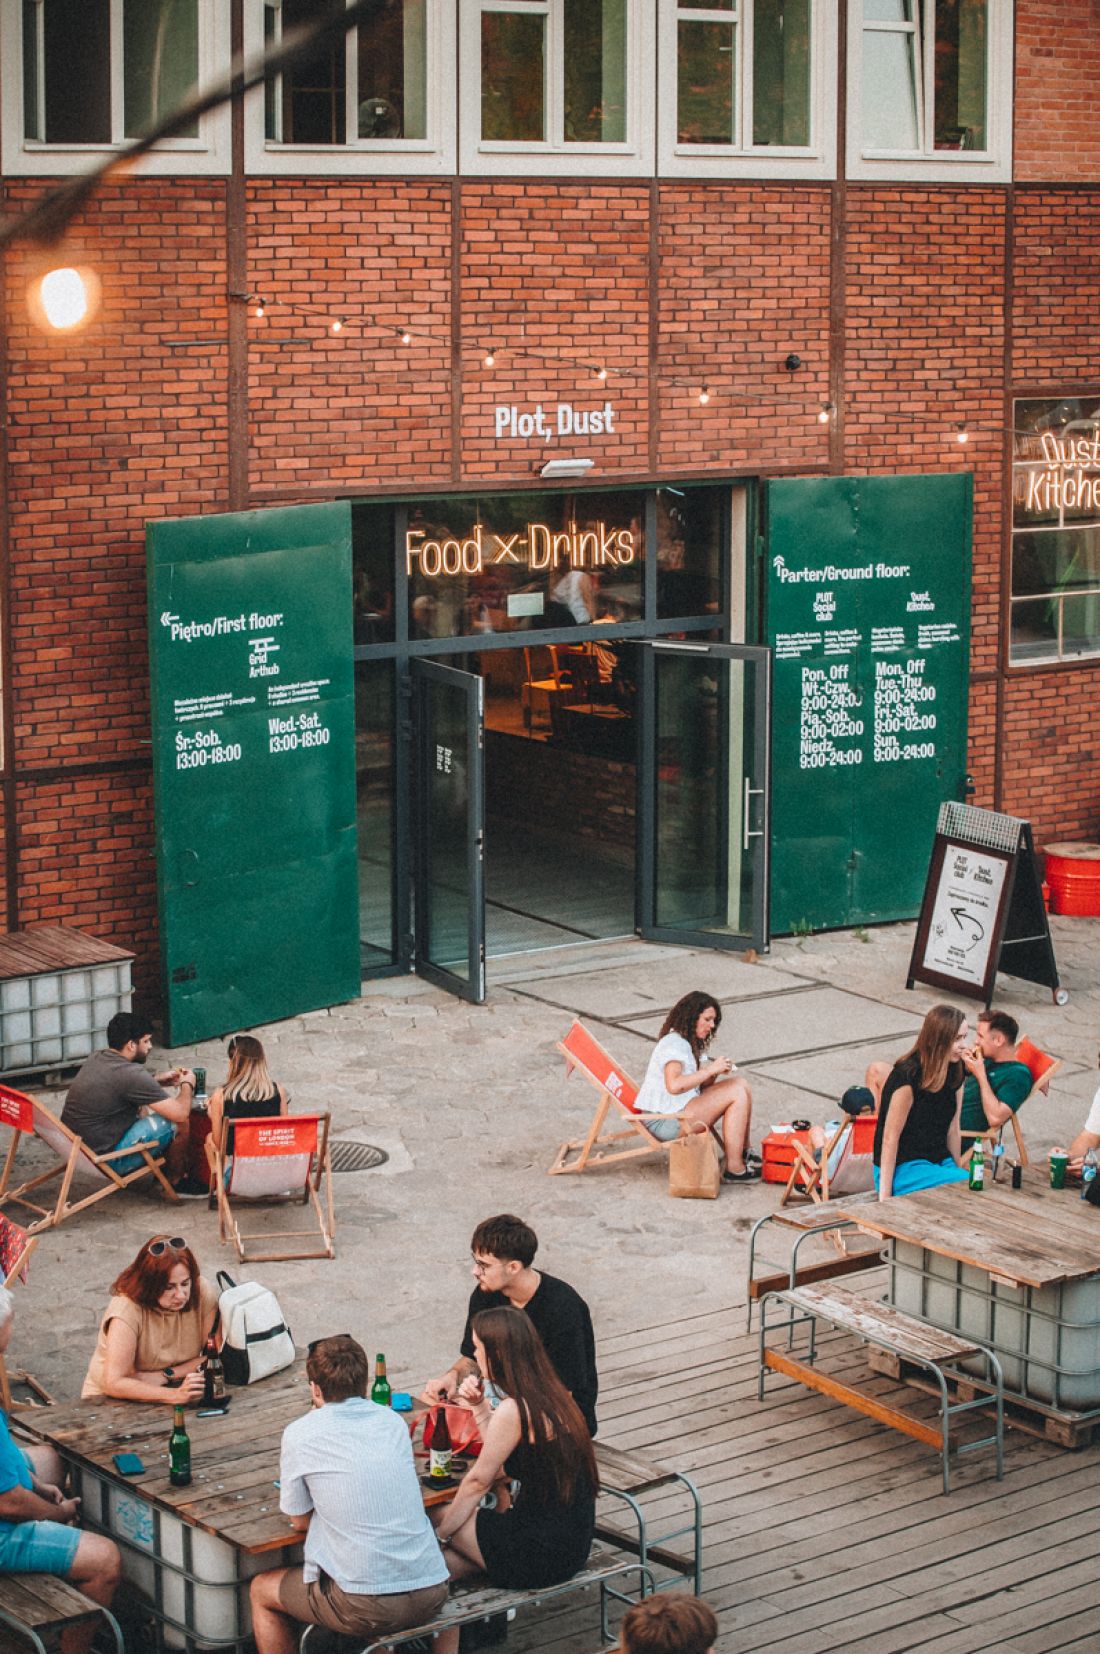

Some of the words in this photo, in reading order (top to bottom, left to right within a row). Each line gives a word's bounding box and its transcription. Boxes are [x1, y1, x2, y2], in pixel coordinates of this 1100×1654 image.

[496, 406, 551, 442] Plot,
[558, 403, 614, 435] Dust
[406, 525, 482, 576] Food
[530, 522, 634, 568] Drinks
[781, 564, 872, 583] Parter/Ground
[876, 564, 910, 578] floor:
[172, 614, 245, 642] Piętro/First
[250, 613, 283, 628] floor:
[249, 652, 267, 665] Grid
[876, 662, 904, 676] Mon.
[907, 659, 925, 673] Off
[249, 663, 279, 678] Arthub
[802, 667, 827, 681] Pon.
[830, 664, 848, 679] Off
[802, 681, 850, 696] Wt.-Czw.
[874, 687, 935, 704] 9:00-24:00
[875, 703, 918, 718] Fri.-Sat.
[269, 713, 321, 735] Wed.-Sat.
[801, 721, 863, 739] 9:00-02:00
[874, 715, 936, 732] 9:00-02:00
[176, 730, 221, 751] Śr.-Sob.
[270, 729, 329, 753] 13:00-18:00
[801, 739, 835, 754] Niedz.
[874, 734, 899, 747] Sun.
[177, 745, 241, 769] 13:00-18:00
[800, 749, 862, 768] 9:00-24:00
[874, 743, 934, 762] 9:00-24:00
